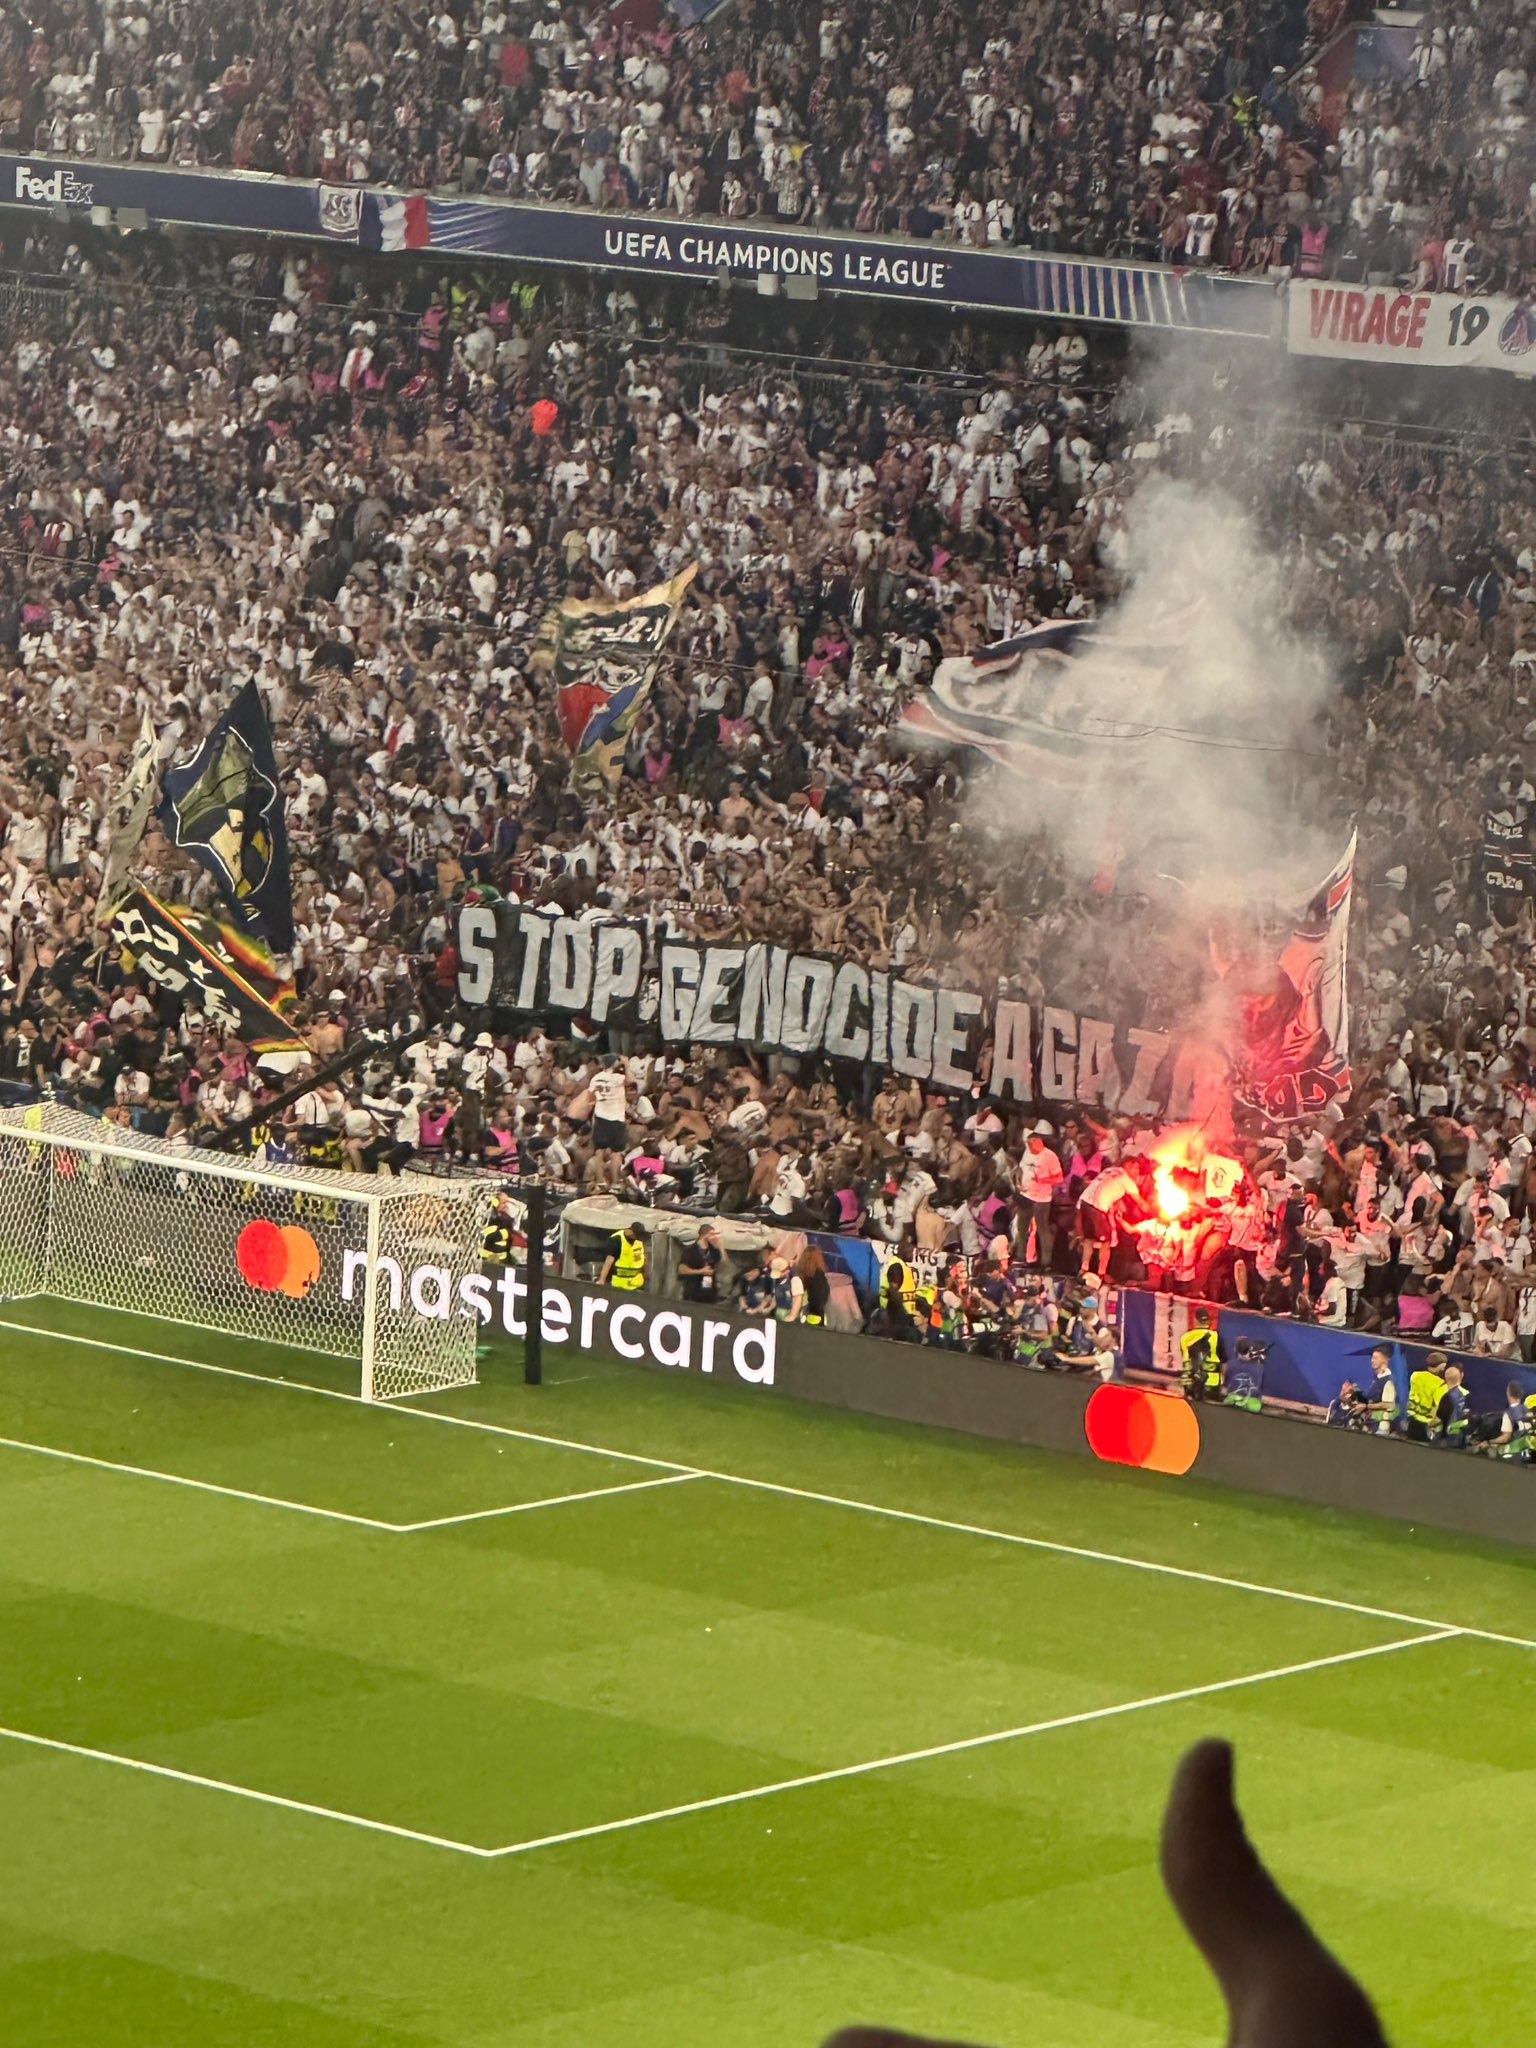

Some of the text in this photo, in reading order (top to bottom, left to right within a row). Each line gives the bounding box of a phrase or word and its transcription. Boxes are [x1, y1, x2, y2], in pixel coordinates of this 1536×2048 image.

[16, 166, 95, 204] FedEx
[604, 229, 945, 289] UEFA CHAMPIONS LEAGUE
[1310, 288, 1491, 350] VIRAGE 19
[457, 906, 643, 1022] STOP
[660, 942, 984, 1091] GENOCIDE
[341, 1247, 777, 1385] mastercard
